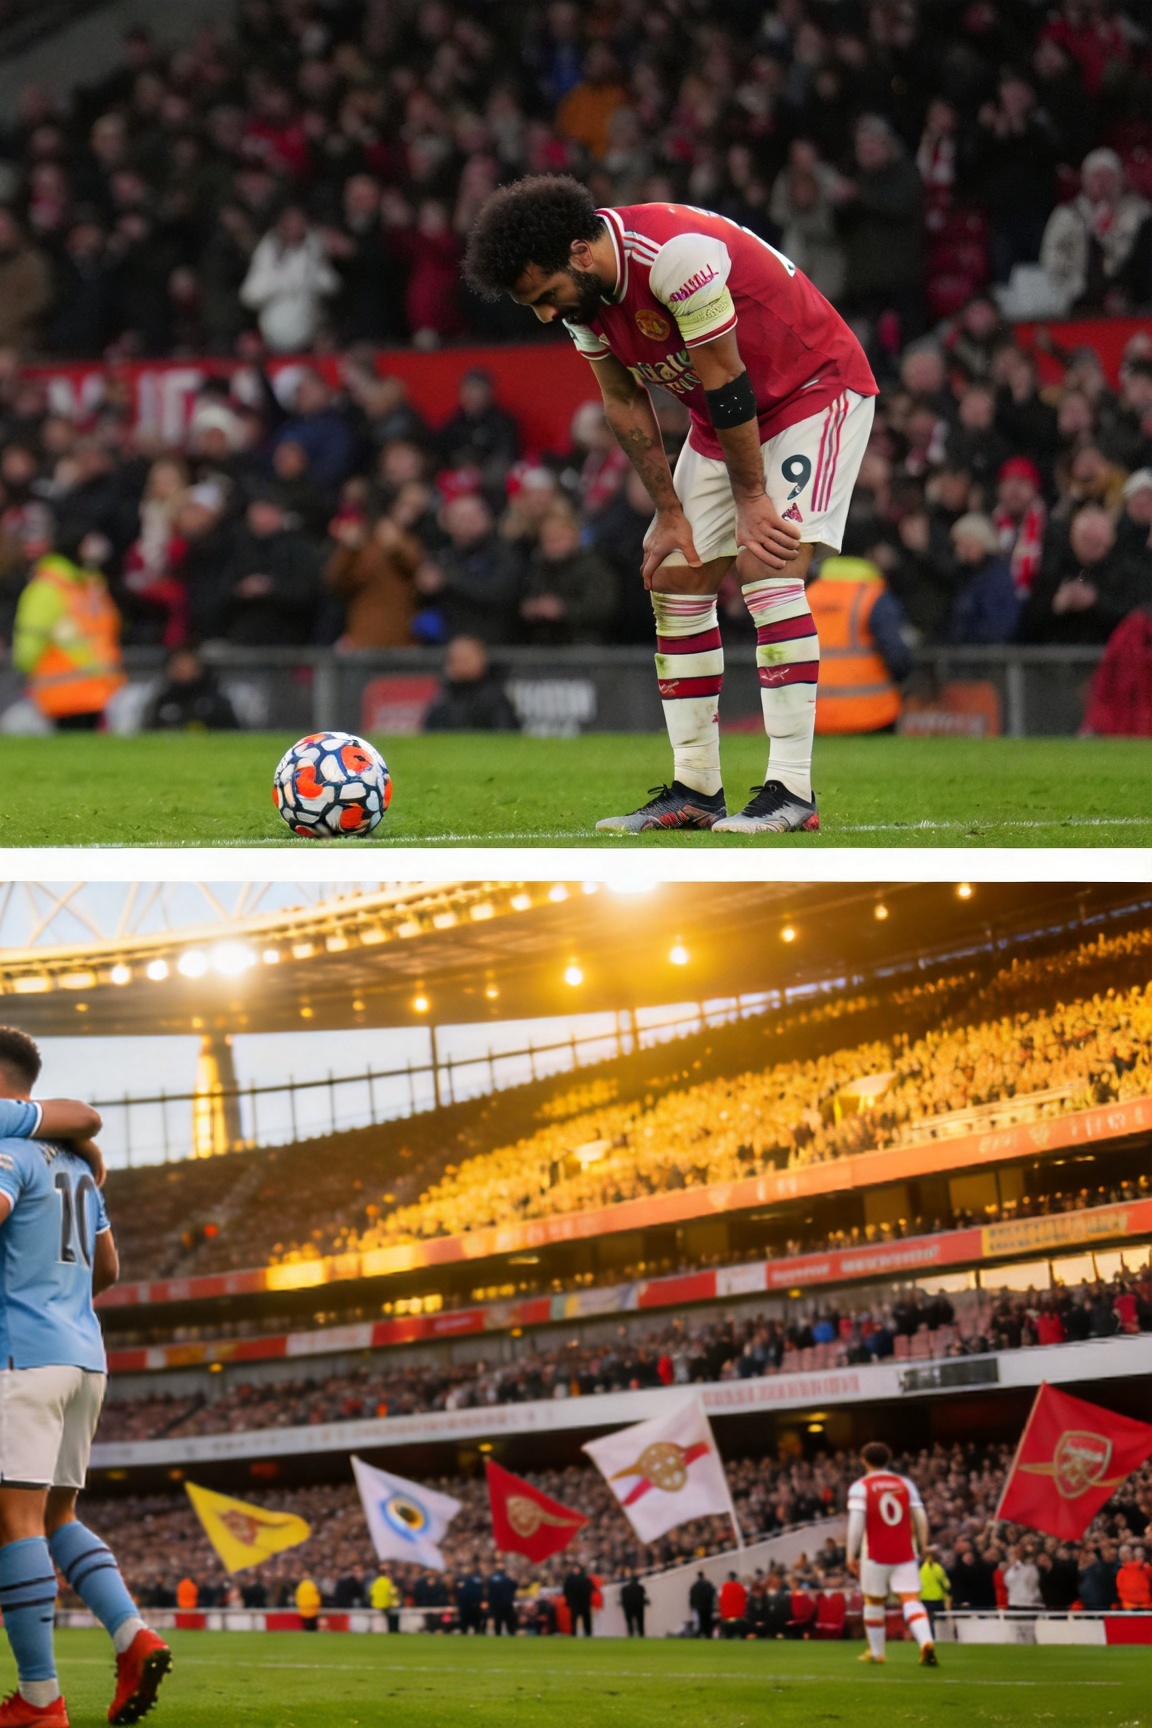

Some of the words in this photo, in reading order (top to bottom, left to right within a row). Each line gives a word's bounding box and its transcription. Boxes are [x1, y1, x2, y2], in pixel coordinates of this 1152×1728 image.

[781, 454, 812, 500] 9
[55, 1171, 94, 1269] 10
[879, 1491, 903, 1526] 6
